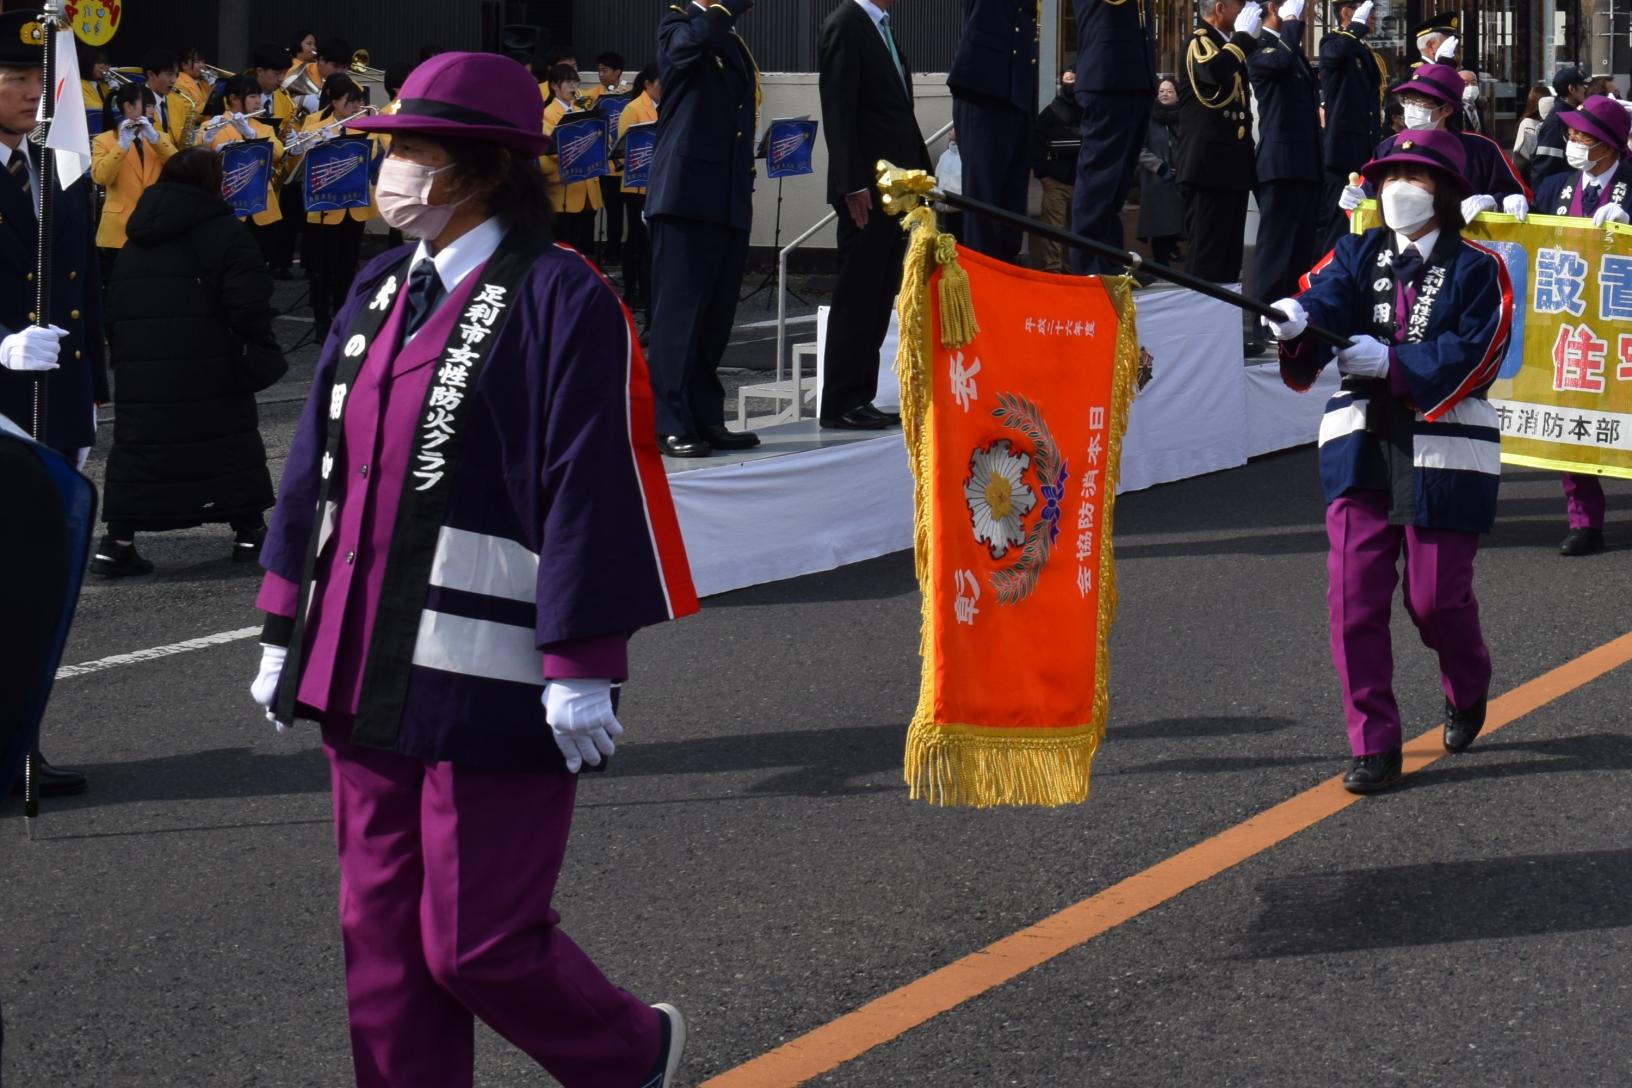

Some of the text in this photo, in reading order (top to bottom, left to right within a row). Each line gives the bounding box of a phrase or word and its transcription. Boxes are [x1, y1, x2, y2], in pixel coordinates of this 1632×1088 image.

[1373, 249, 1394, 344] 火の用
[412, 283, 508, 491] 足利市女性防火クラブ
